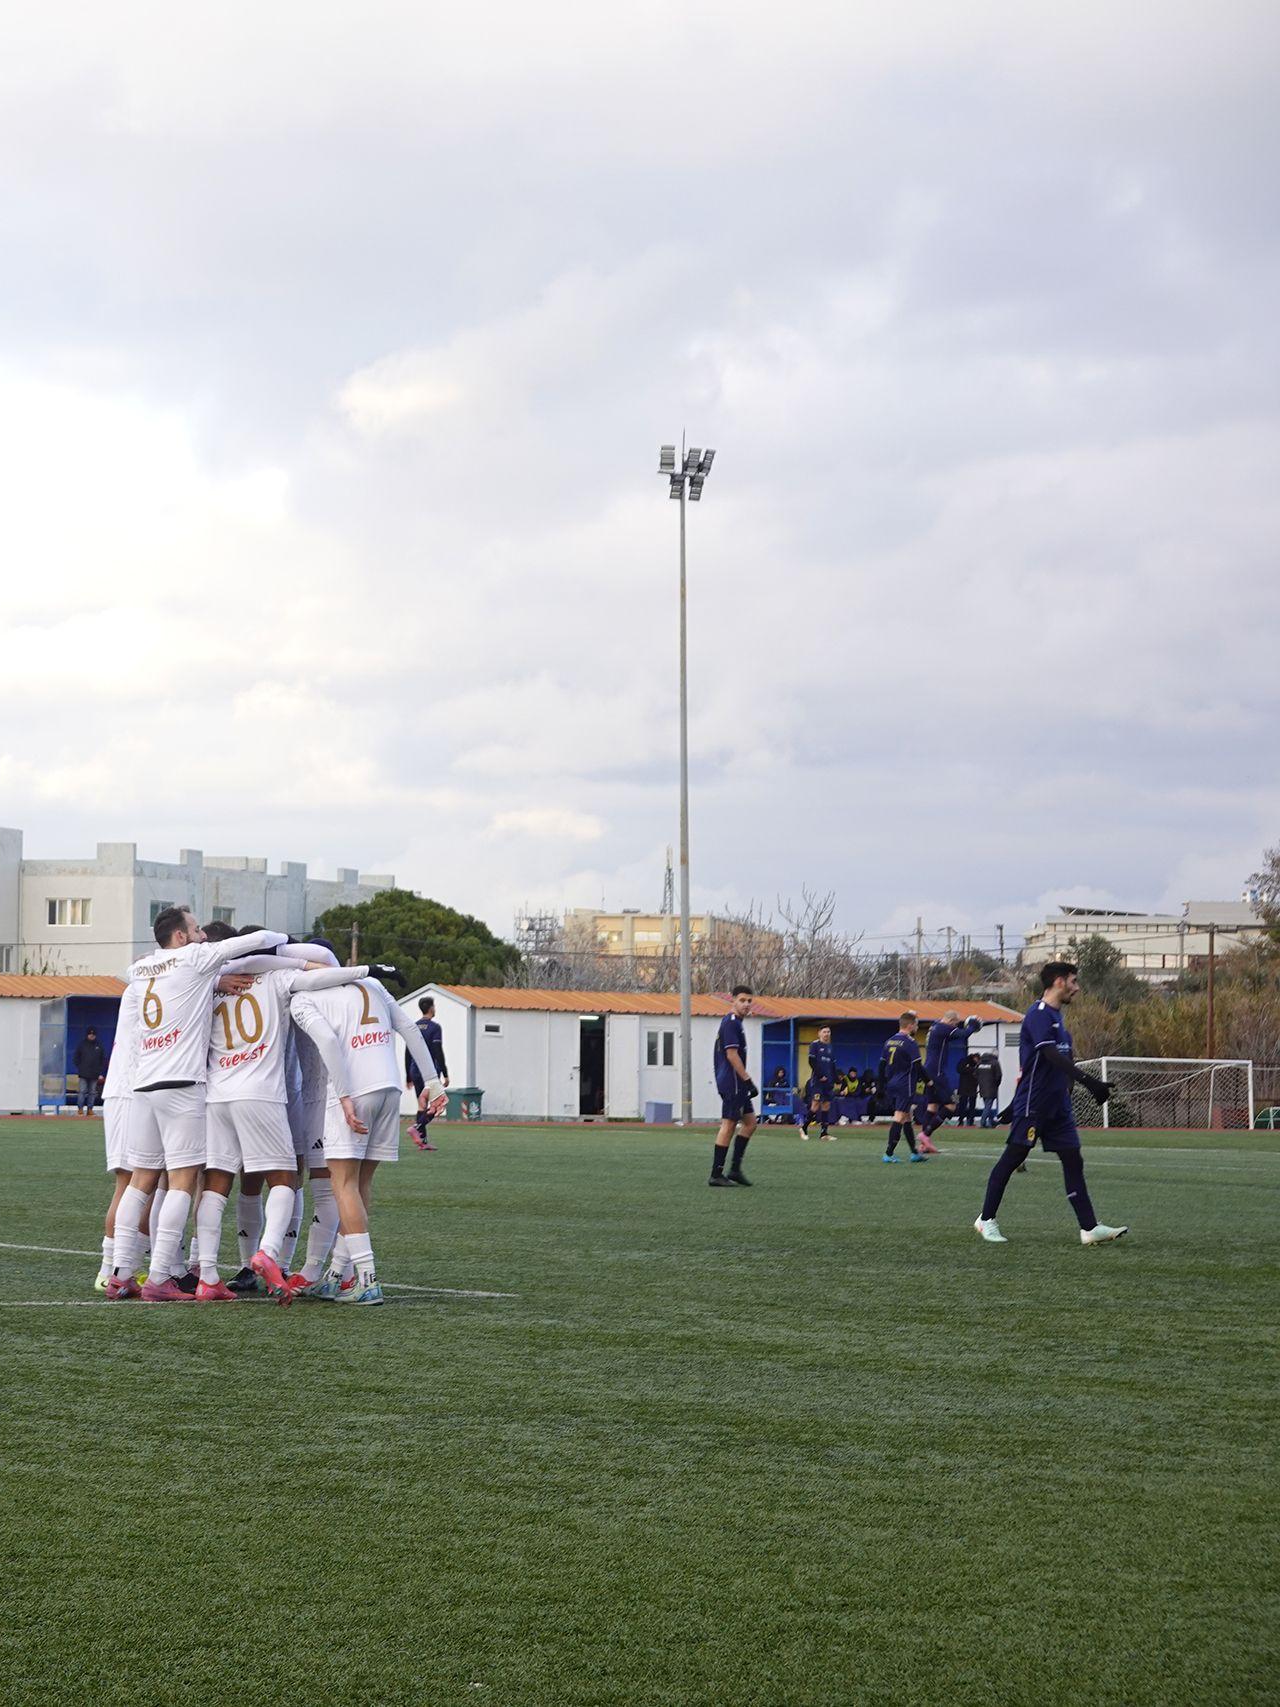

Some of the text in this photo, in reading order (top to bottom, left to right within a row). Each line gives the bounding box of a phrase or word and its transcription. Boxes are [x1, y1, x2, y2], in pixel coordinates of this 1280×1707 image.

[143, 977, 163, 1029] 6
[213, 992, 263, 1050] 10
[350, 982, 380, 1025] 2
[142, 1027, 182, 1050] verest
[888, 1047, 897, 1065] 7
